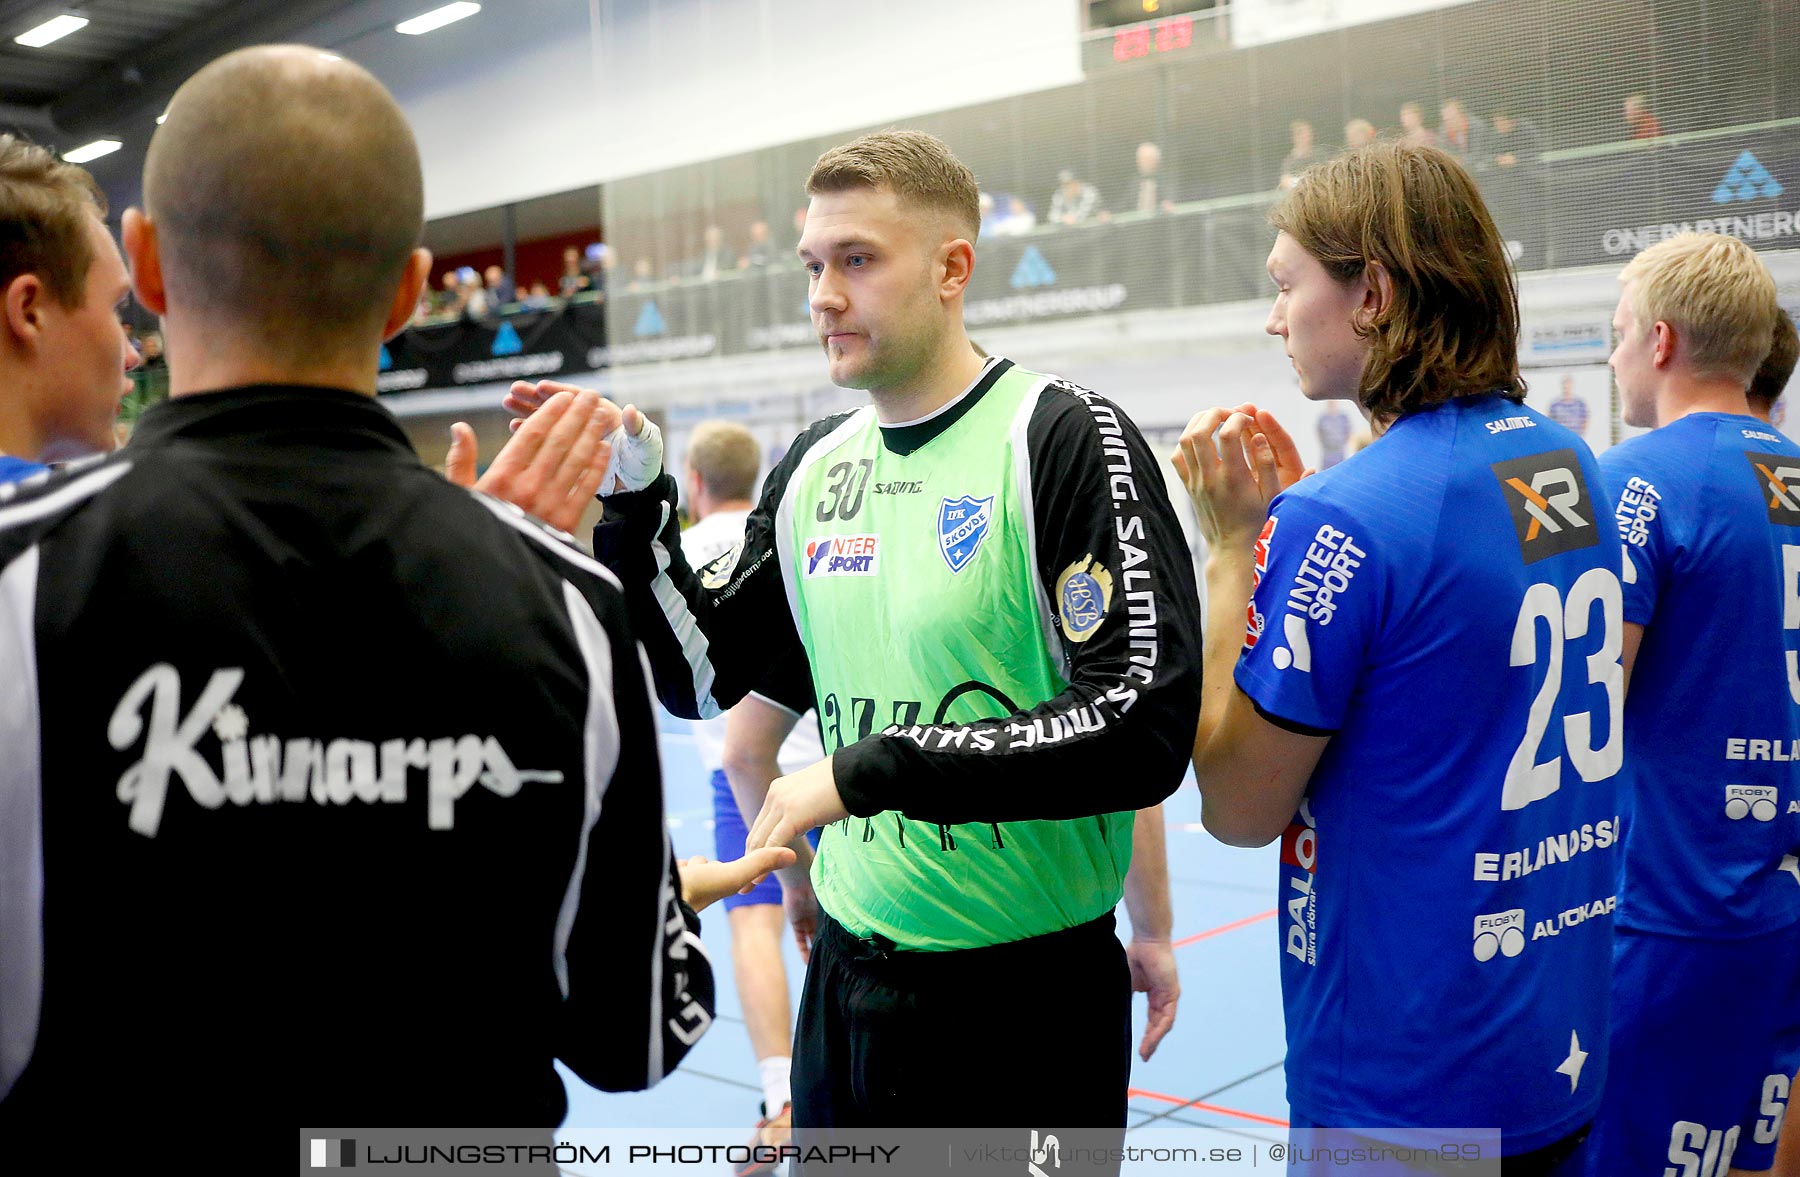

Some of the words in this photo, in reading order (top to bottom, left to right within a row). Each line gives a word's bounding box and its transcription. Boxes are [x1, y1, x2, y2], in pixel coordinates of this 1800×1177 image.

[816, 459, 874, 523] 30
[1505, 467, 1590, 542] XR
[1627, 483, 1662, 547] SPORT
[945, 513, 986, 546] SKÖVDE
[1287, 524, 1345, 613] INTER
[1308, 536, 1367, 626] SPORT
[1501, 567, 1624, 811] 23
[107, 662, 564, 838] Kinnarps
[1731, 788, 1772, 797] FLOBY
[1480, 913, 1519, 929] FLOBY
